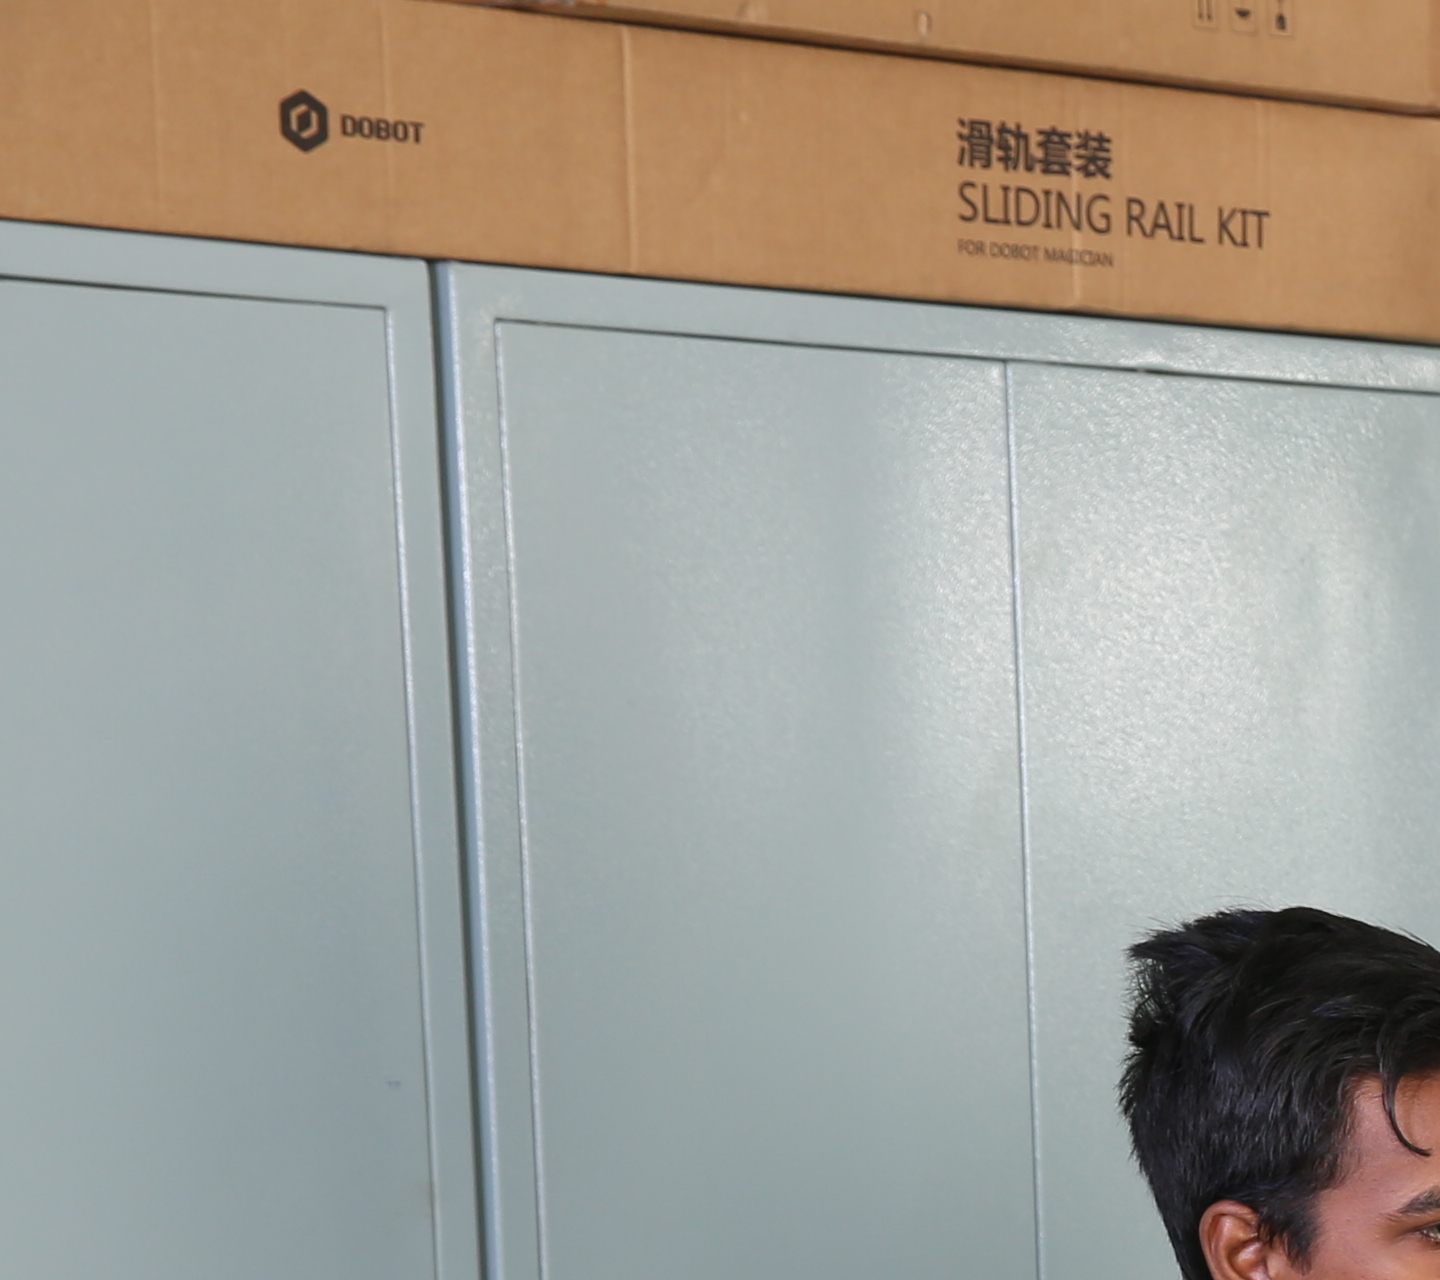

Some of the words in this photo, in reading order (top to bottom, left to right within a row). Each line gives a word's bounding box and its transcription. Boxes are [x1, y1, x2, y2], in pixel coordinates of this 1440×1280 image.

[340, 114, 424, 143] DOBOT
[957, 117, 1112, 180] 滑轨套装
[958, 181, 1111, 236] SLIDING
[1126, 197, 1205, 243] RAIL
[1217, 206, 1269, 249] KIT
[957, 239, 986, 256] FOR
[989, 241, 1039, 261] DOBOT
[1043, 246, 1115, 268] MAGICIAN
